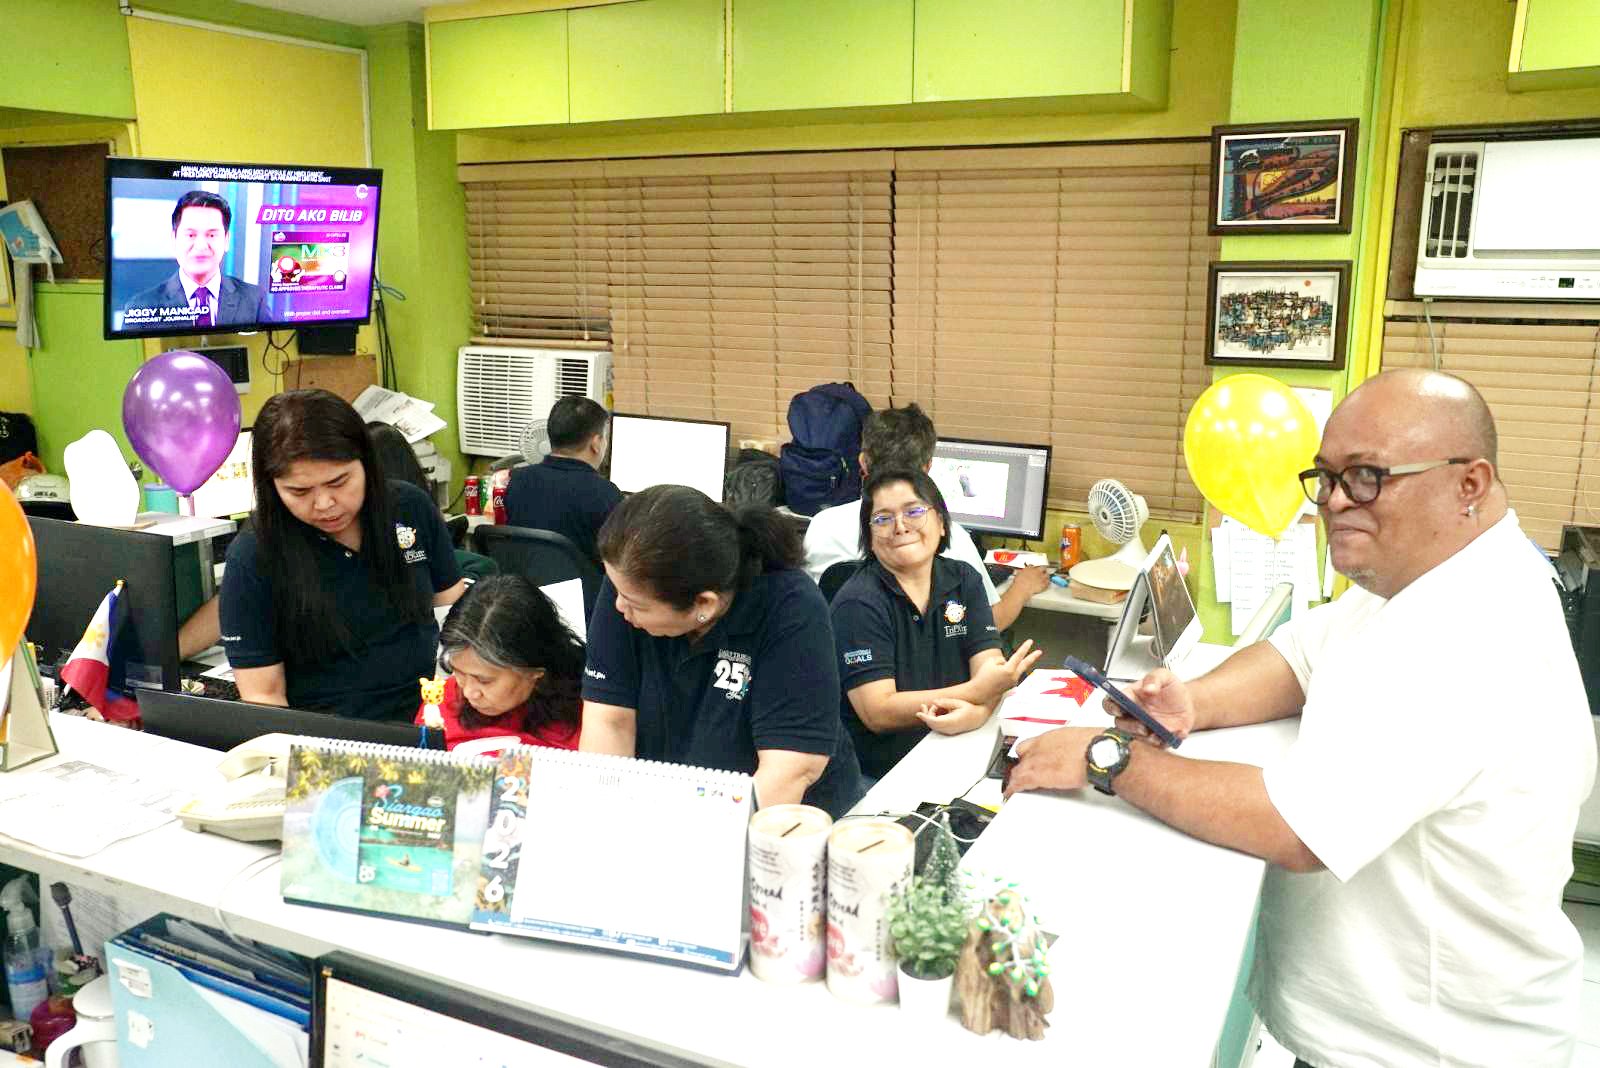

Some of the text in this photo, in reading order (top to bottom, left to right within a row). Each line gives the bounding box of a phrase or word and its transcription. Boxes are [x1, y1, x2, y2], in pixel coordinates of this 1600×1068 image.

[262, 208, 363, 222] DITO AKO BILIB
[124, 306, 210, 318] JIGGY MANICAD
[713, 659, 746, 693] 25
[369, 806, 447, 832] Summer
